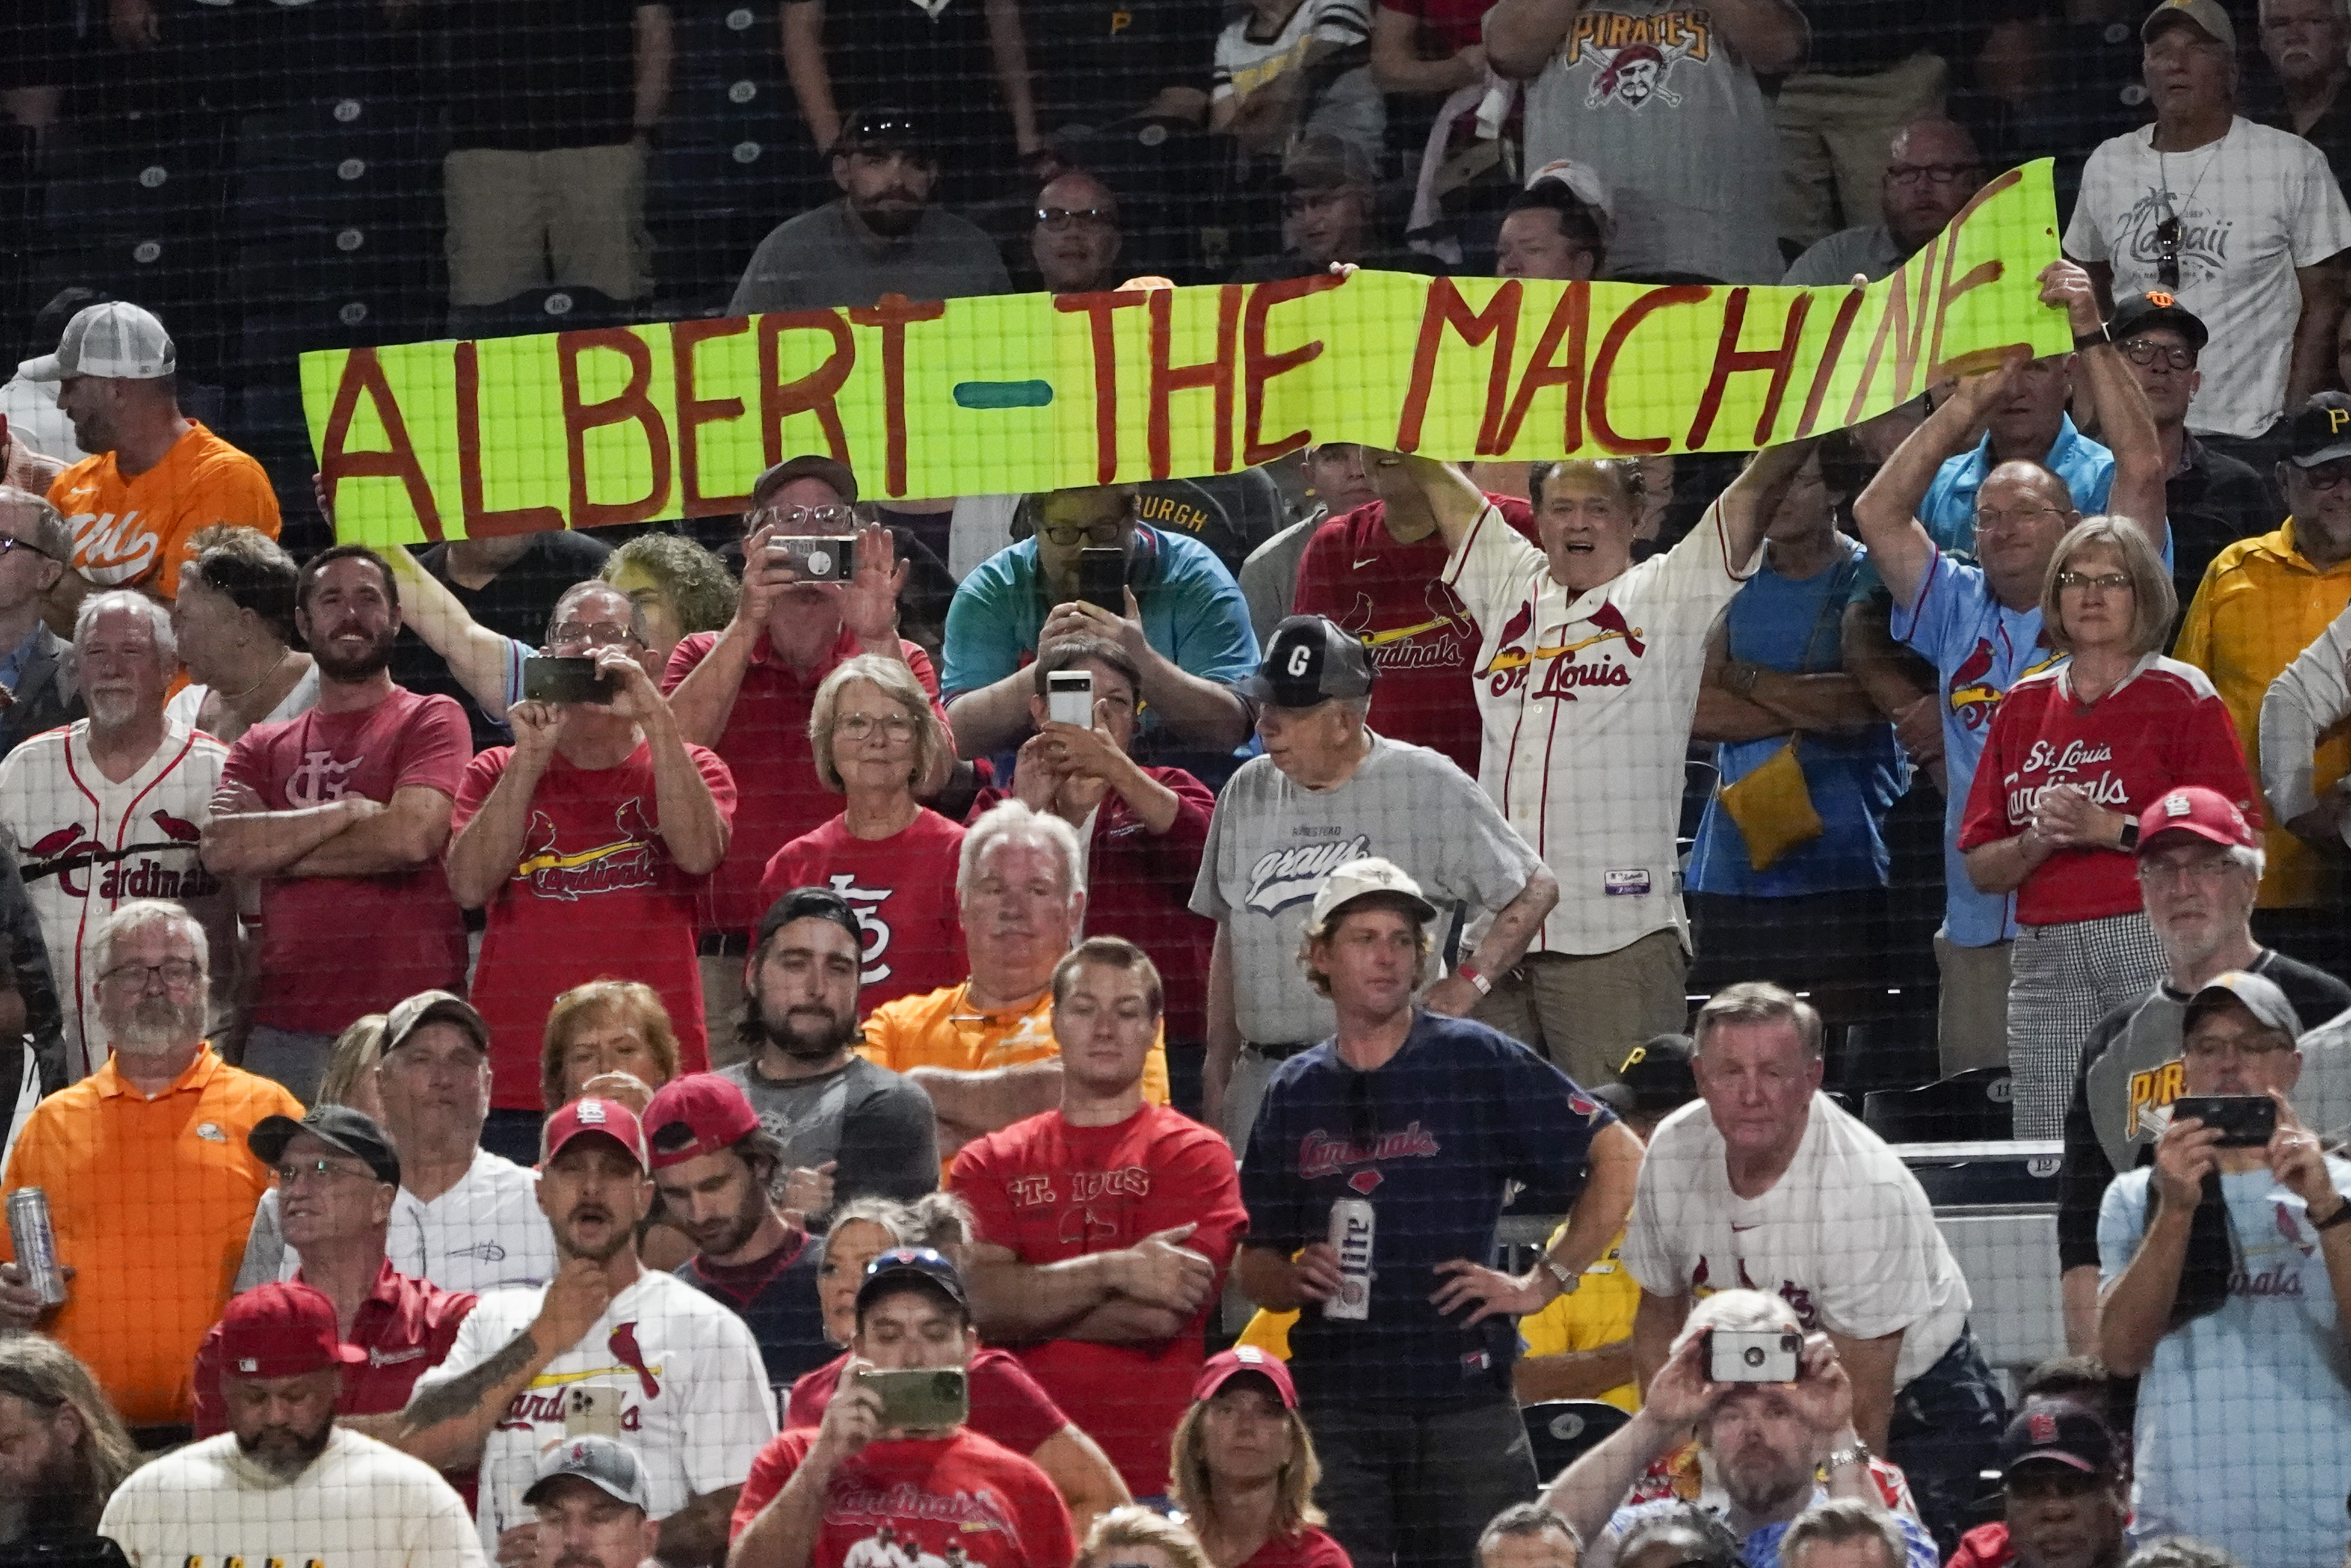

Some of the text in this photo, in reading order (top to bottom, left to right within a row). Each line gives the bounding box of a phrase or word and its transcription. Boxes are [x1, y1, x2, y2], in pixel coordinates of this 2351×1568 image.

[1112, 11, 1132, 34] P
[1566, 8, 1712, 66] PIRATES
[2113, 208, 2232, 267] Haaii
[322, 298, 944, 542] ALBERT
[1053, 272, 1349, 485] THE
[1397, 170, 2035, 456] MACHINE
[2329, 408, 2350, 434] P
[1287, 647, 1311, 678] G
[1532, 650, 1632, 701] Louis
[2048, 739, 2112, 774] Louis
[1619, 1047, 1646, 1074] P
[2036, 1158, 2053, 1172] 12
